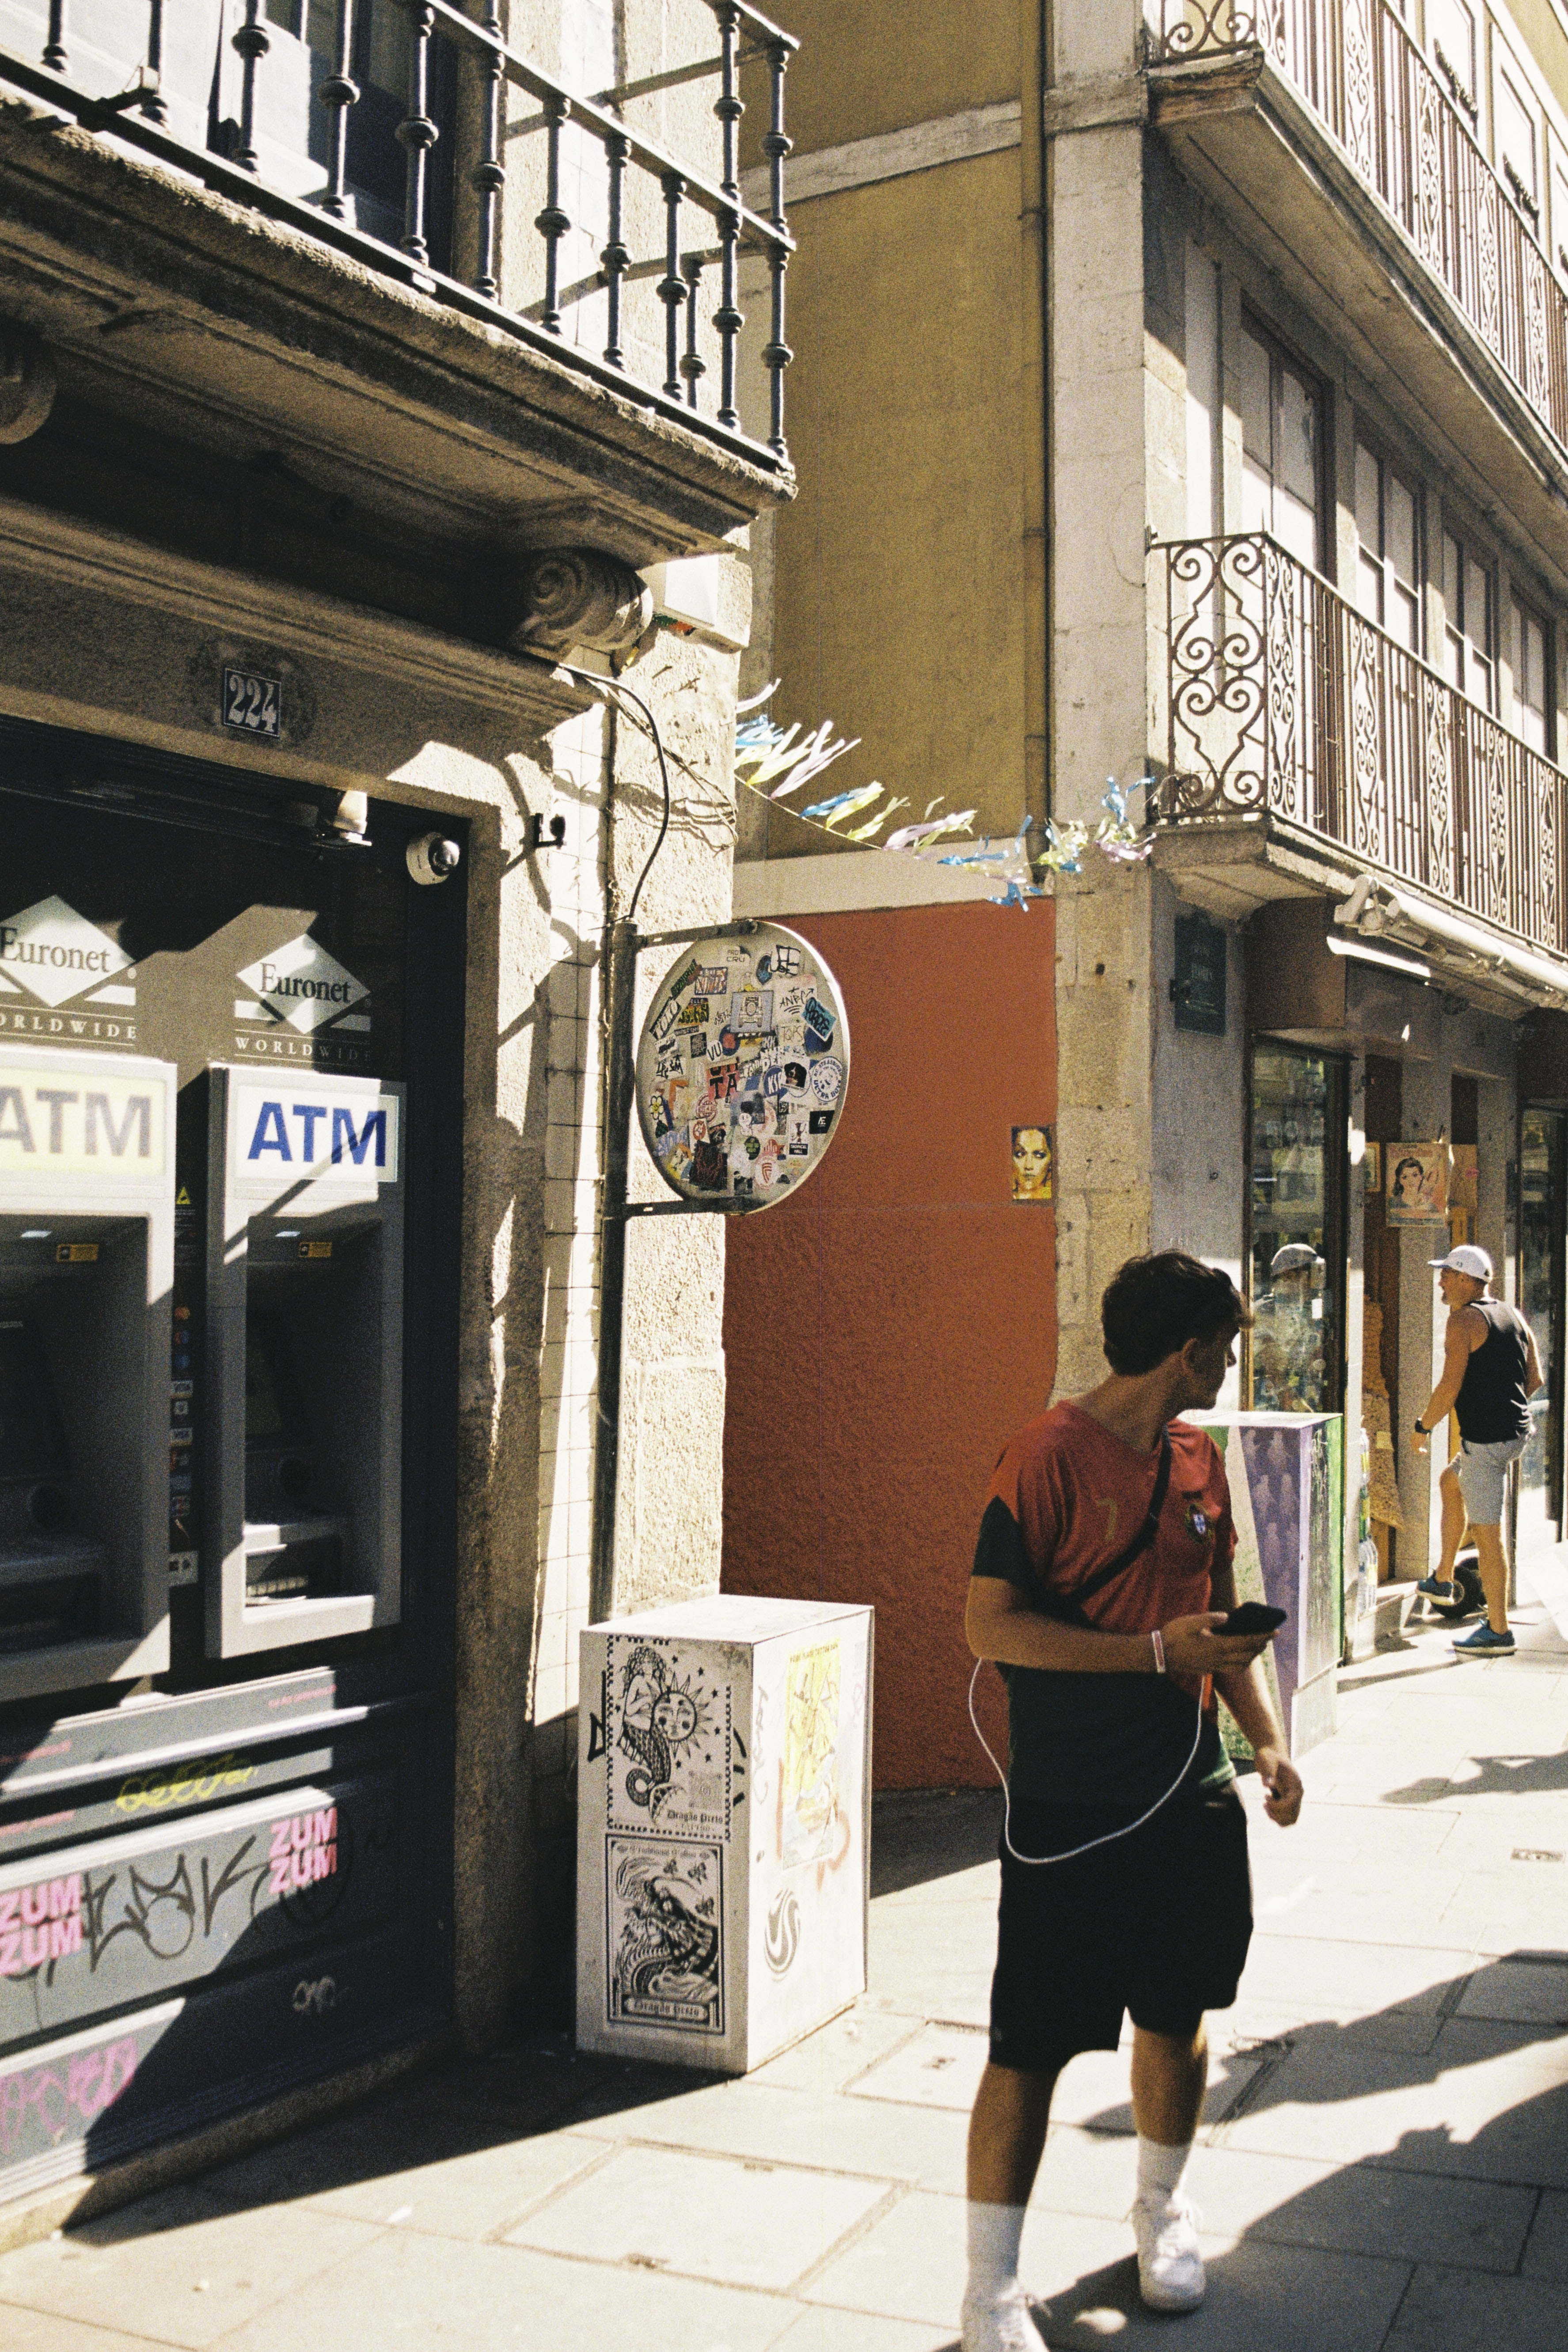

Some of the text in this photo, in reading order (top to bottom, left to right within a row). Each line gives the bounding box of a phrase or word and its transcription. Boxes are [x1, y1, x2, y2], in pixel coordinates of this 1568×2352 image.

[228, 674, 277, 732] 224
[0, 926, 110, 973] Euronet
[261, 963, 351, 1004] Euronet
[0, 1014, 136, 1039] RLDWIDE
[236, 1036, 372, 1062] WORLDWIDE
[813, 1079, 829, 1099] ULTRA
[0, 1085, 152, 1158] ATM
[248, 1102, 386, 1168] ATM
[1095, 1498, 1118, 1541] 7
[270, 1806, 338, 1858] ZUM
[269, 1844, 338, 1895] ZUM
[0, 1872, 81, 1934] ZUM
[0, 1913, 81, 1976] ZUM
